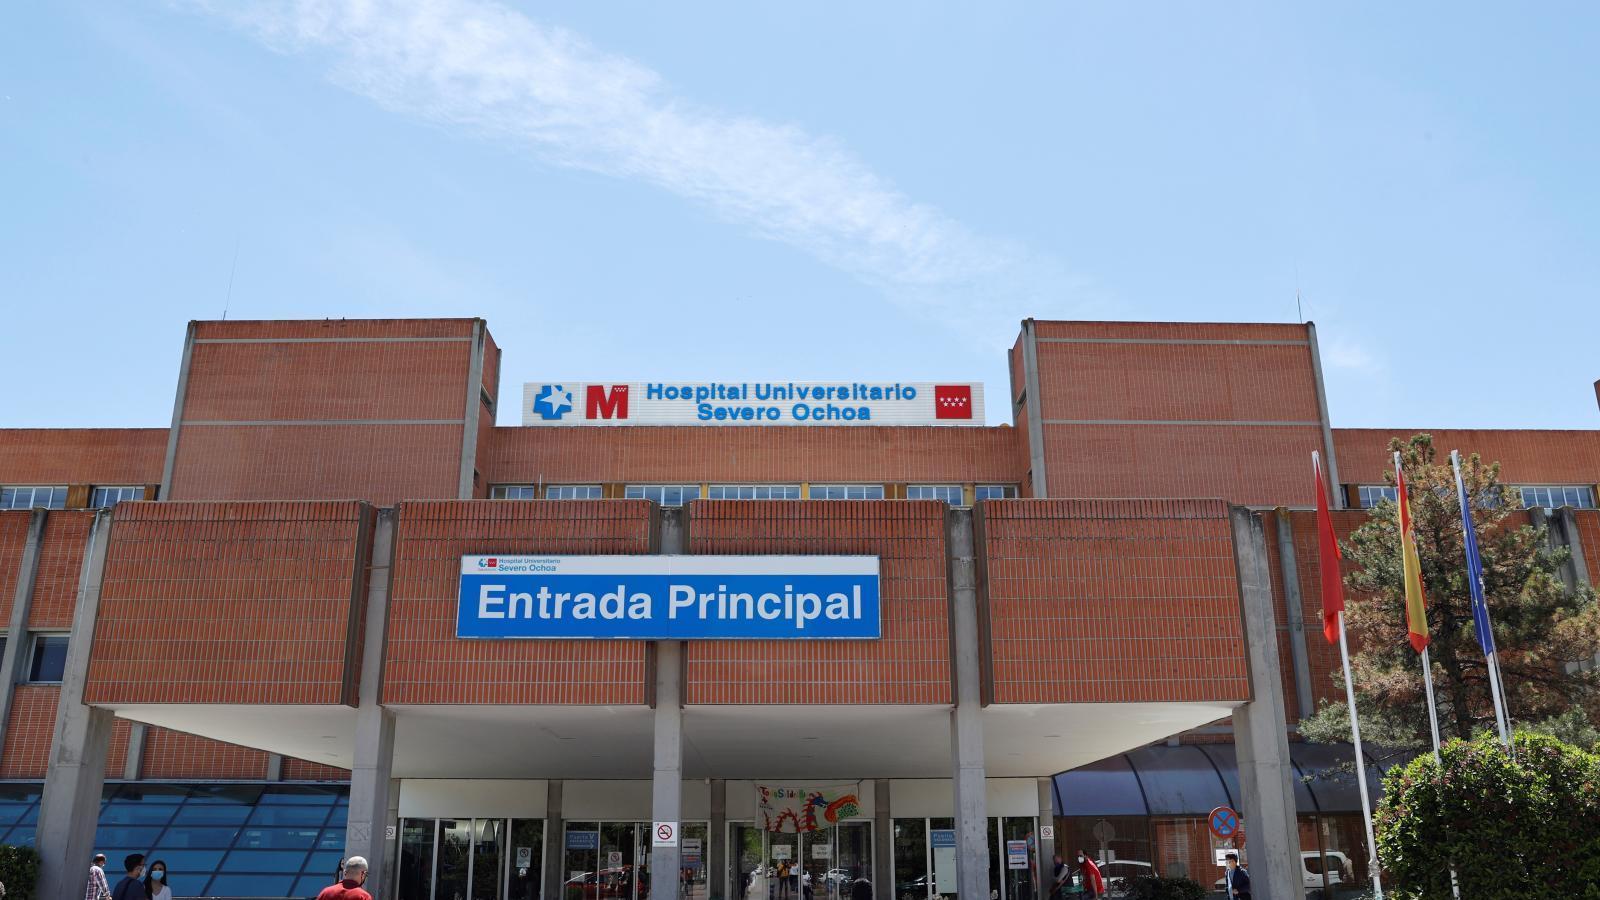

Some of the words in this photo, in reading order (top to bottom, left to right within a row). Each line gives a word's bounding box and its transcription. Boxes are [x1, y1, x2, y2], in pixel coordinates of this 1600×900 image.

[586, 385, 629, 420] M
[647, 383, 748, 404] Hospital
[755, 382, 917, 401] Universitario
[697, 403, 781, 421] Severo
[791, 403, 871, 421] Ochoa
[498, 564, 527, 572] Severo
[529, 564, 557, 572] Ochoa
[478, 584, 652, 620] Entrada
[668, 584, 862, 629] Principal
